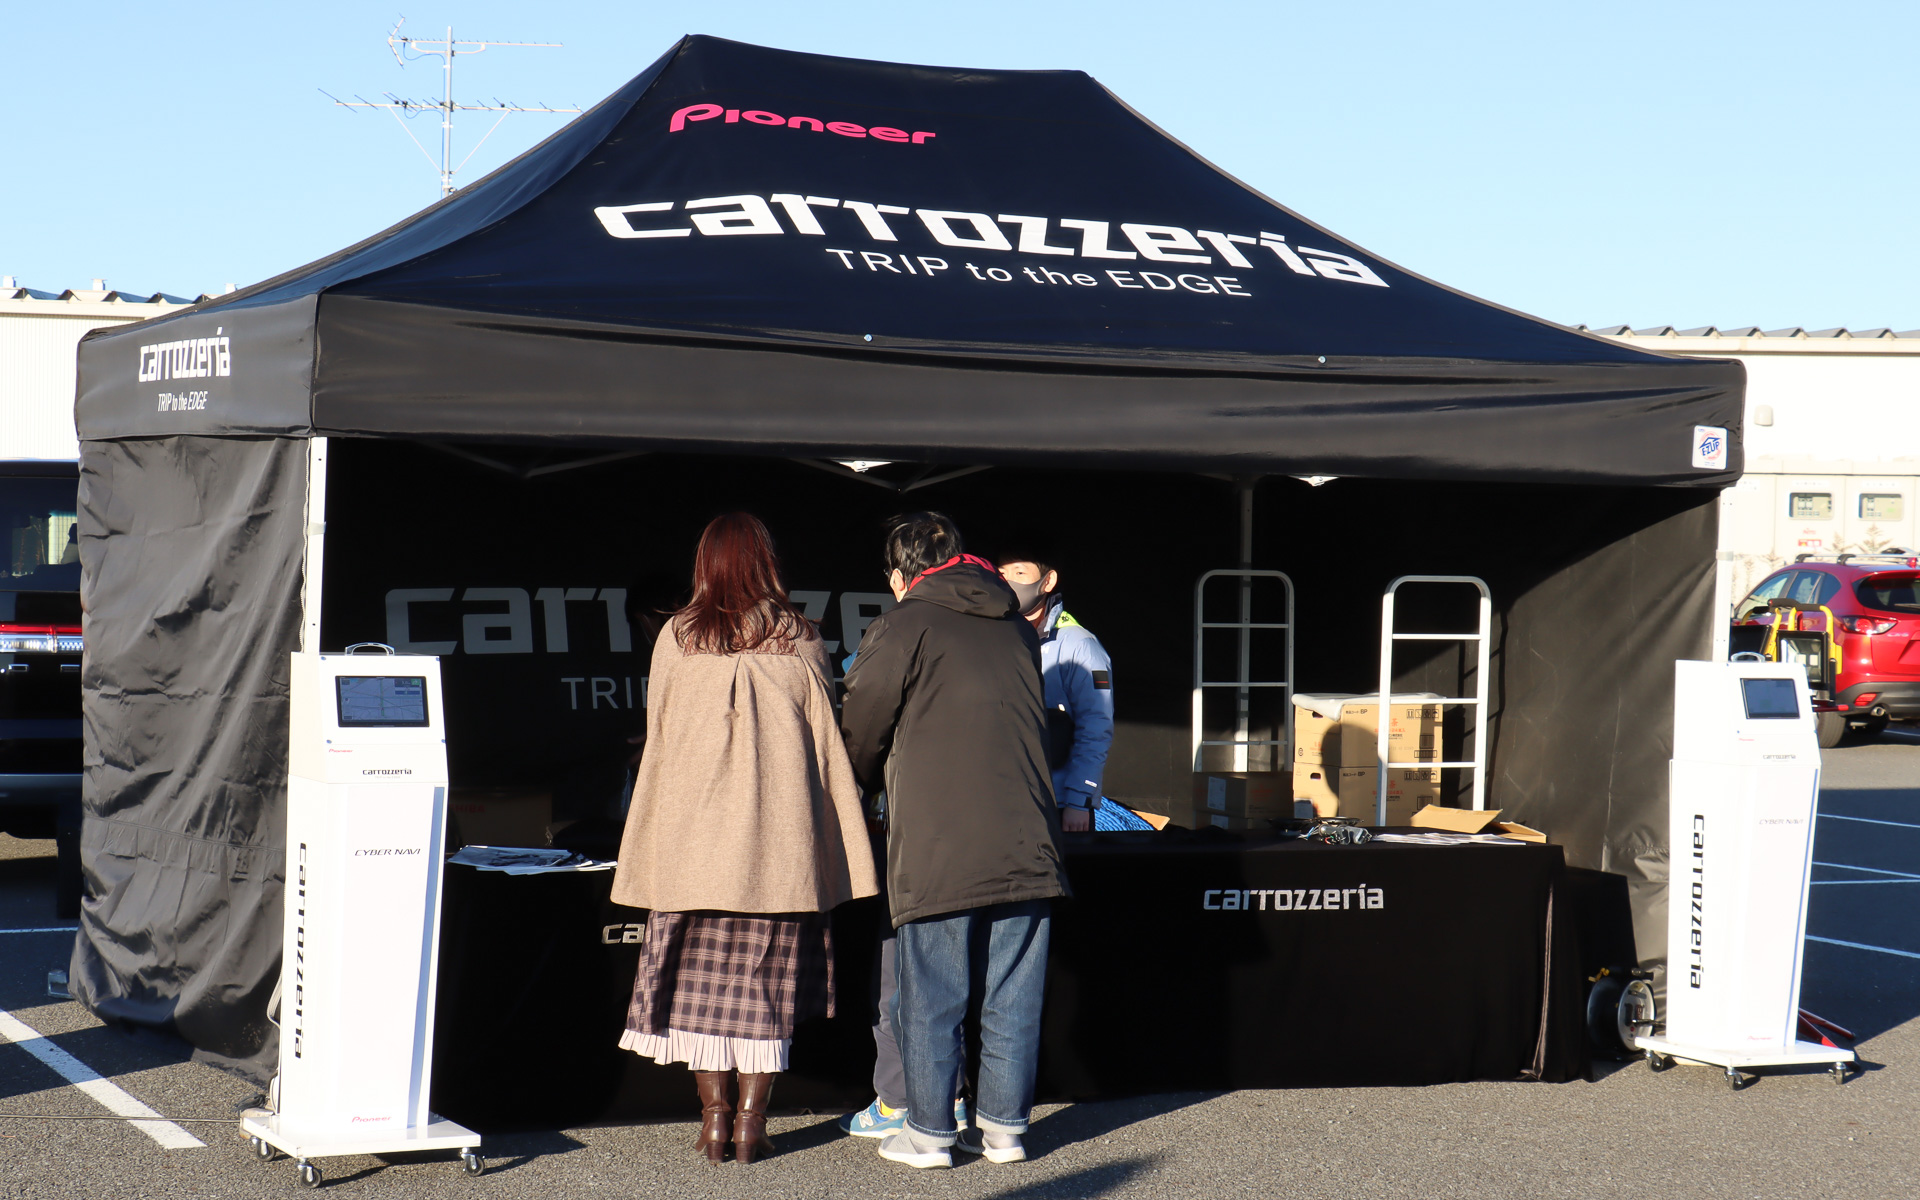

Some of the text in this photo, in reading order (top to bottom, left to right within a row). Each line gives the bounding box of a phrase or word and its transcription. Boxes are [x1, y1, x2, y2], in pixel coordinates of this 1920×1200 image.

[669, 103, 936, 144] Pioneer
[594, 193, 1390, 287] carrozzeria
[825, 248, 1253, 298] TRIP to the EDGE
[139, 326, 231, 383] carrozzeria
[157, 391, 208, 412] TRIP to the EDGE
[362, 767, 413, 775] carrozzeria
[355, 848, 421, 857] CYBER NAVI
[1203, 883, 1385, 911] carrozzeria
[1690, 814, 1705, 989] carrozzeria
[295, 842, 306, 1059] carrozzeria
[352, 1115, 392, 1123] Pioneer
